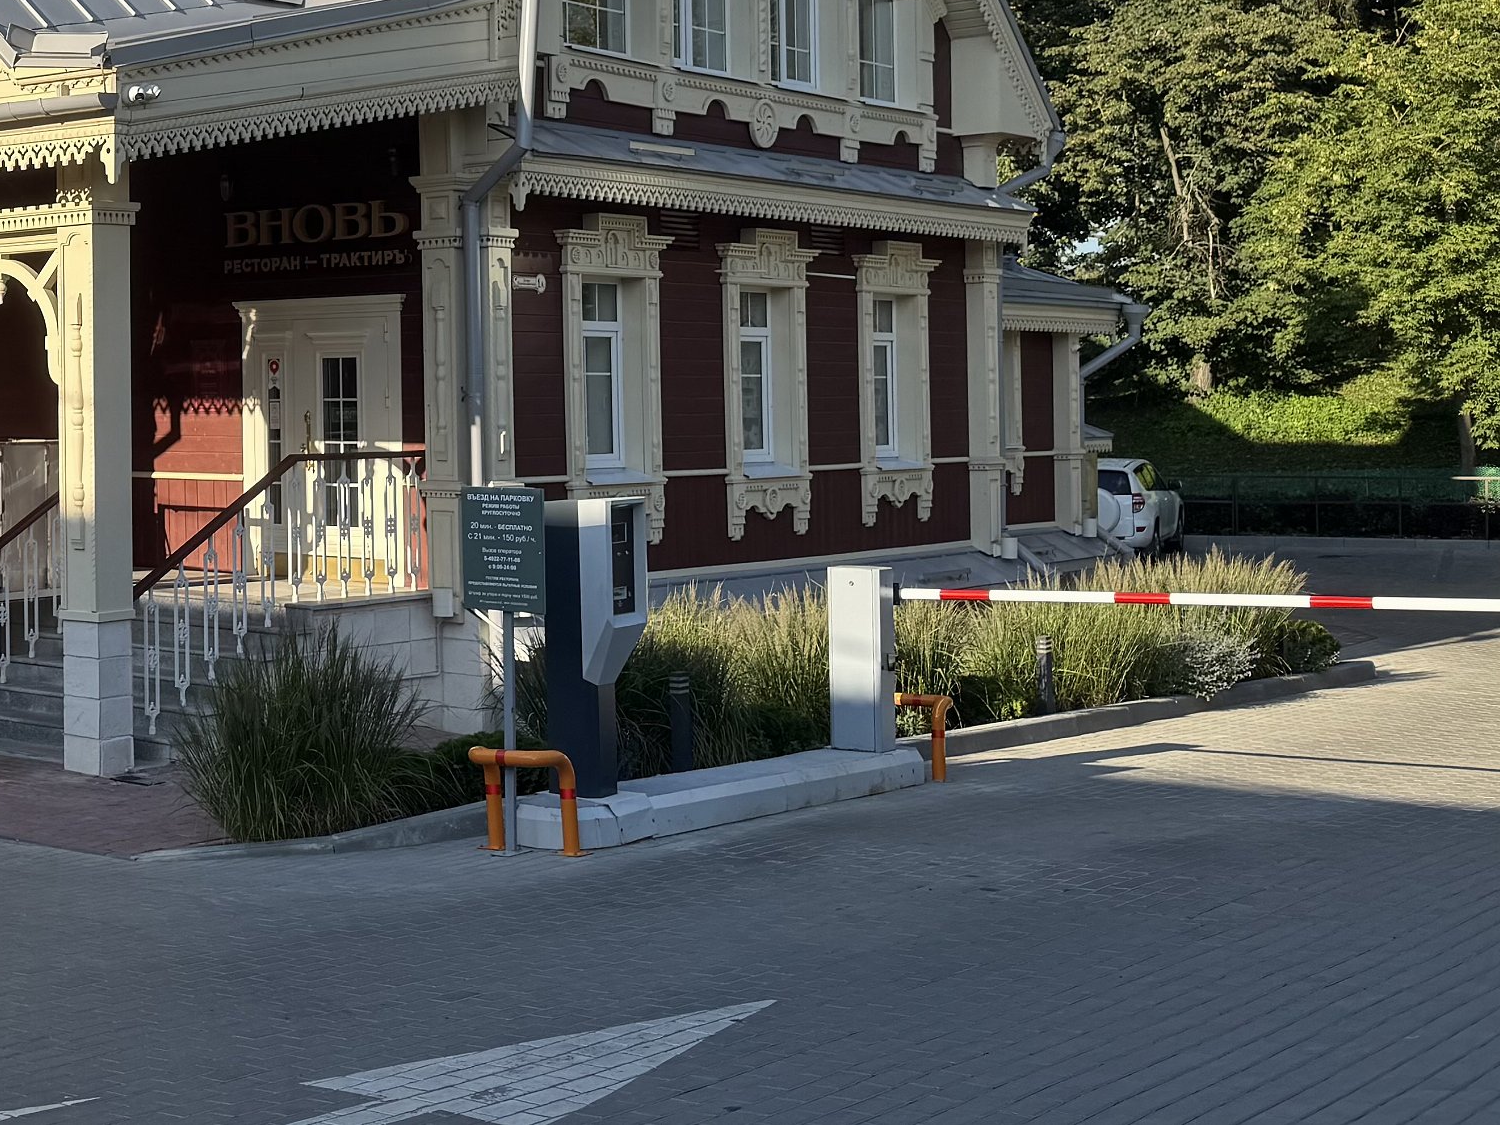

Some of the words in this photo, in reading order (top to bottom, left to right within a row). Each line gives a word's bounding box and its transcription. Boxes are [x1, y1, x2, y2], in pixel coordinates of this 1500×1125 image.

[223, 199, 411, 249] ВНОВЬ
[223, 255, 301, 274] РЕСТОРАН
[320, 249, 406, 269] ТРАКТИРЪ
[466, 493, 489, 502] ВЪЕЗД
[500, 495, 534, 503] ПАРКОВКУ
[470, 521, 479, 529] 20
[497, 524, 533, 532] БЕСПЛАТНО
[502, 534, 514, 542] 150
